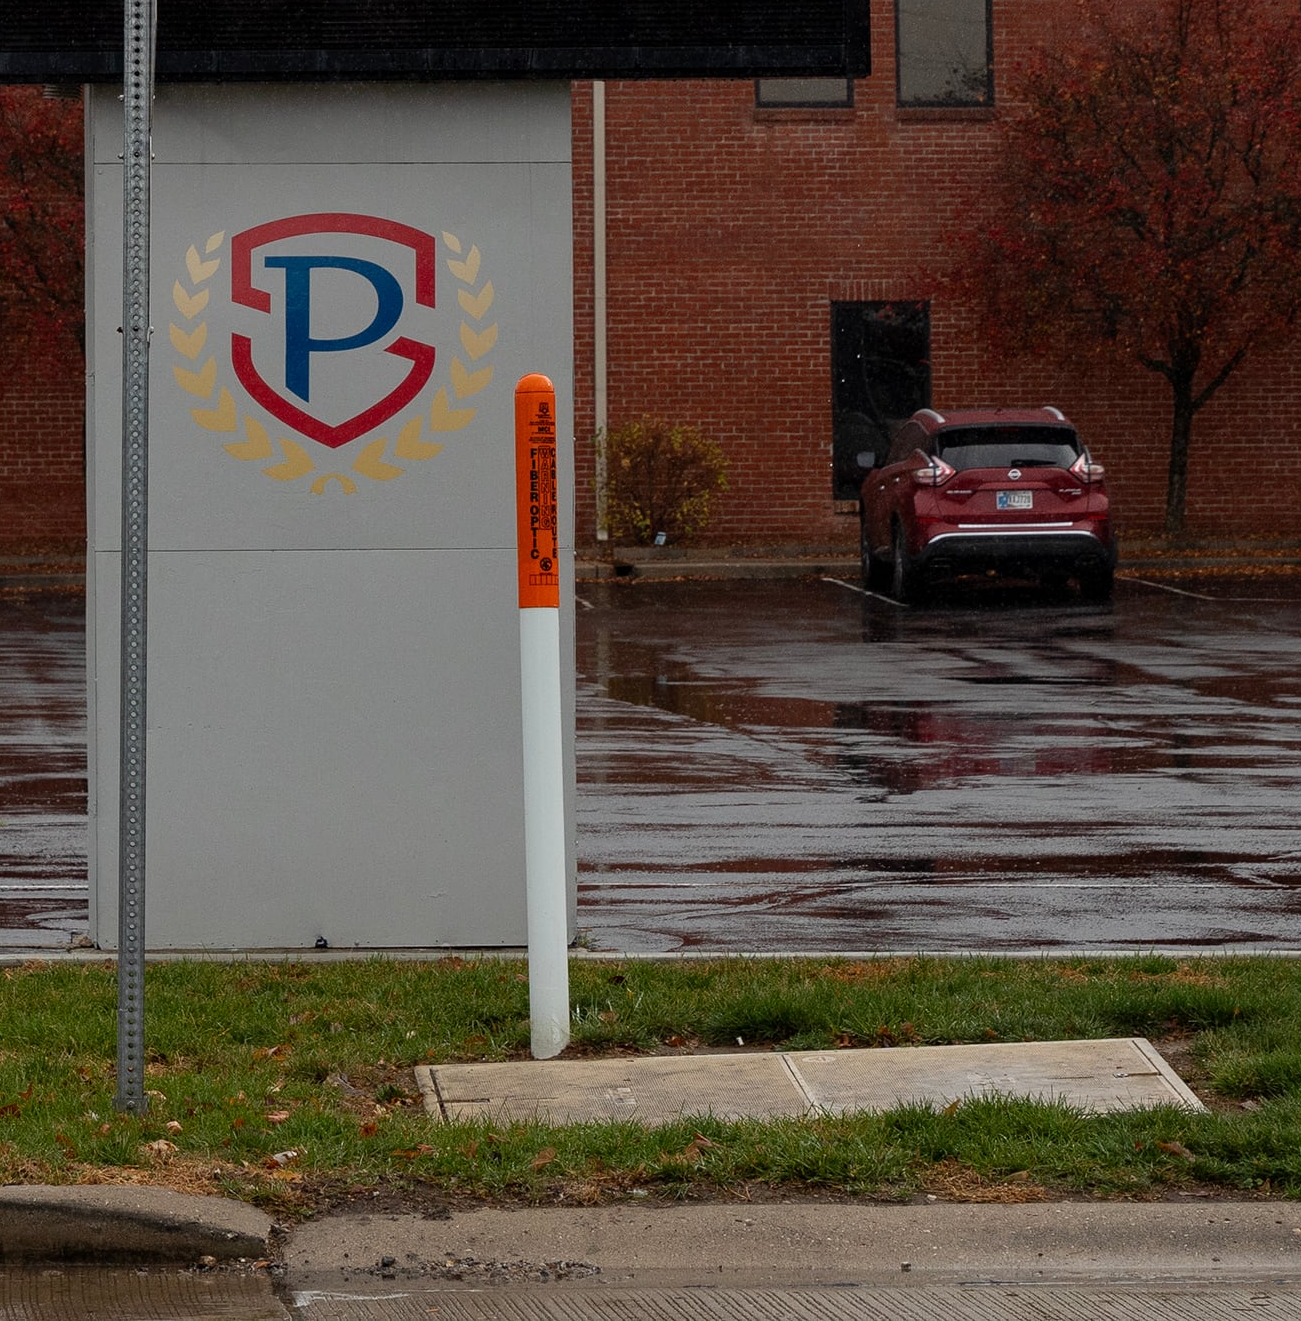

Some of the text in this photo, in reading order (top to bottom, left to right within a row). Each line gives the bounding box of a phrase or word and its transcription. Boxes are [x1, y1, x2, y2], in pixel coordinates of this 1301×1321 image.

[530, 447, 540, 559] FIBER OPTIC
[539, 448, 550, 529] WARNING
